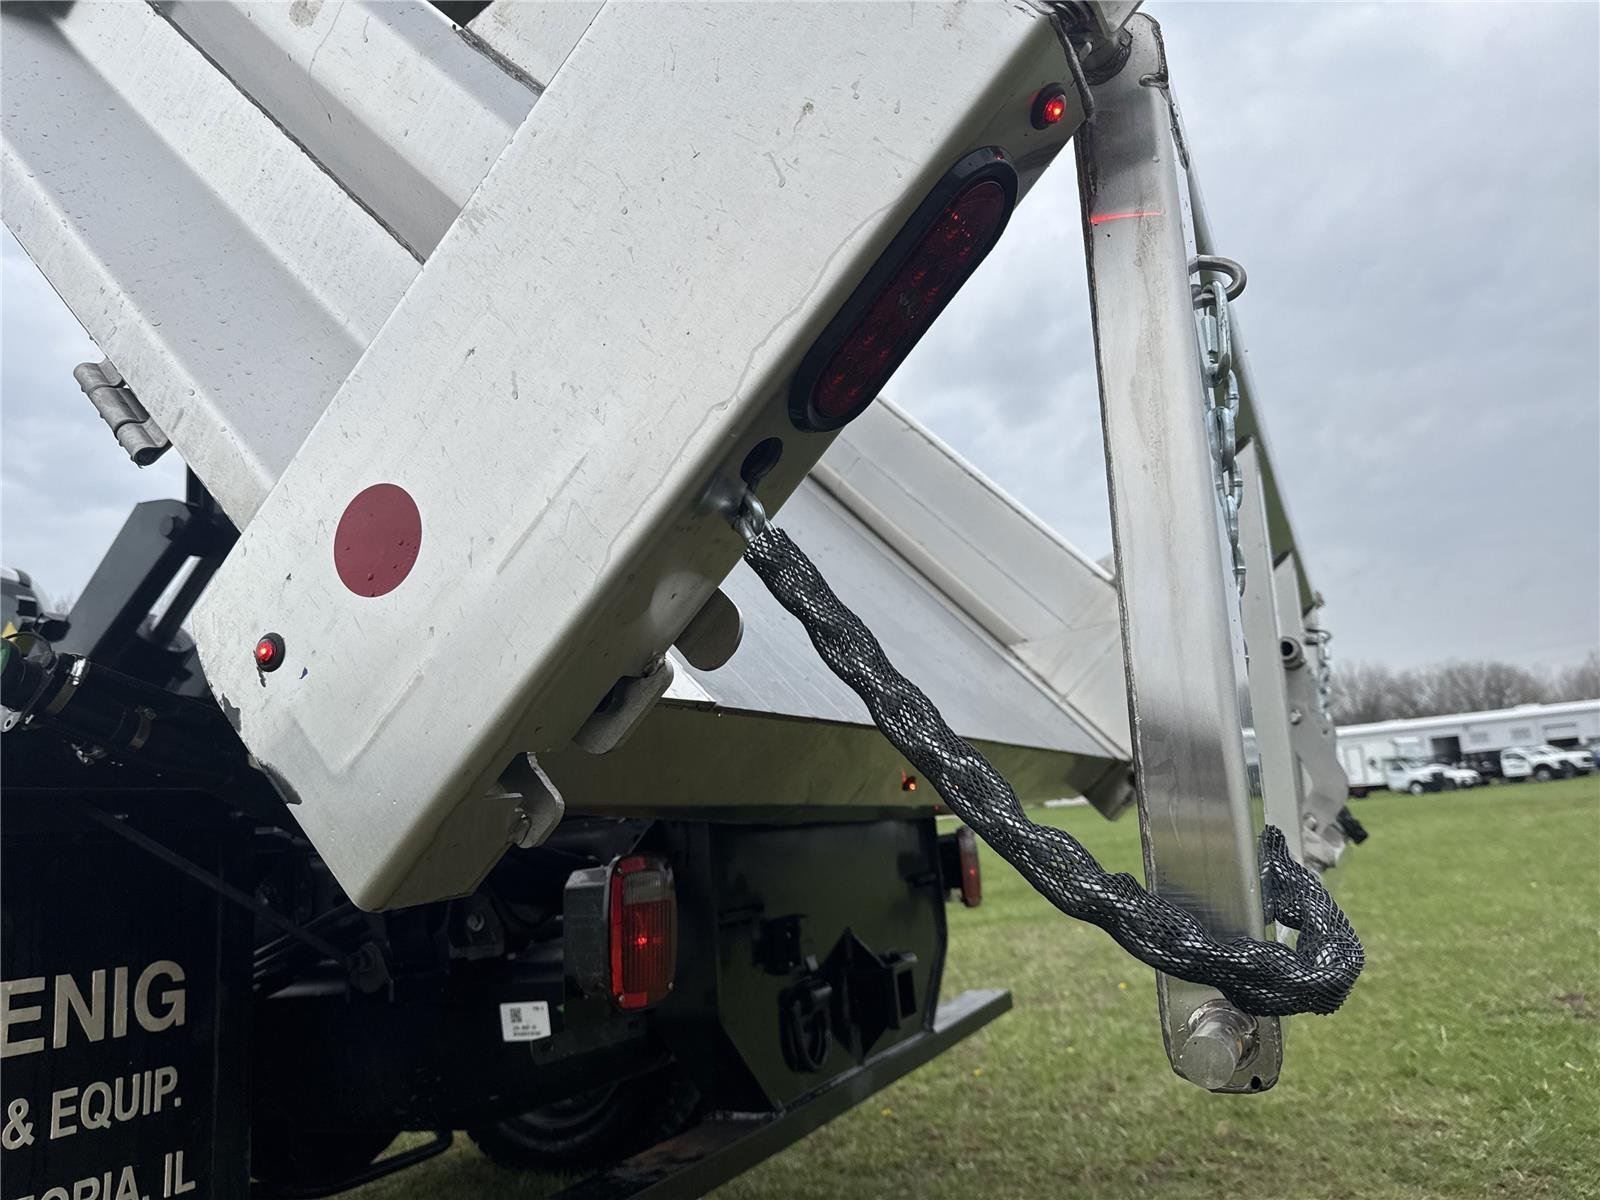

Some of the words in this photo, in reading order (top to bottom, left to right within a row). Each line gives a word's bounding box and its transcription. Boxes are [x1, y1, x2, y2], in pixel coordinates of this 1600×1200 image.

[0, 960, 186, 1059] ENIG
[1, 1098, 35, 1150] &
[50, 1066, 182, 1140] EQUIP.
[163, 1150, 196, 1198] IL
